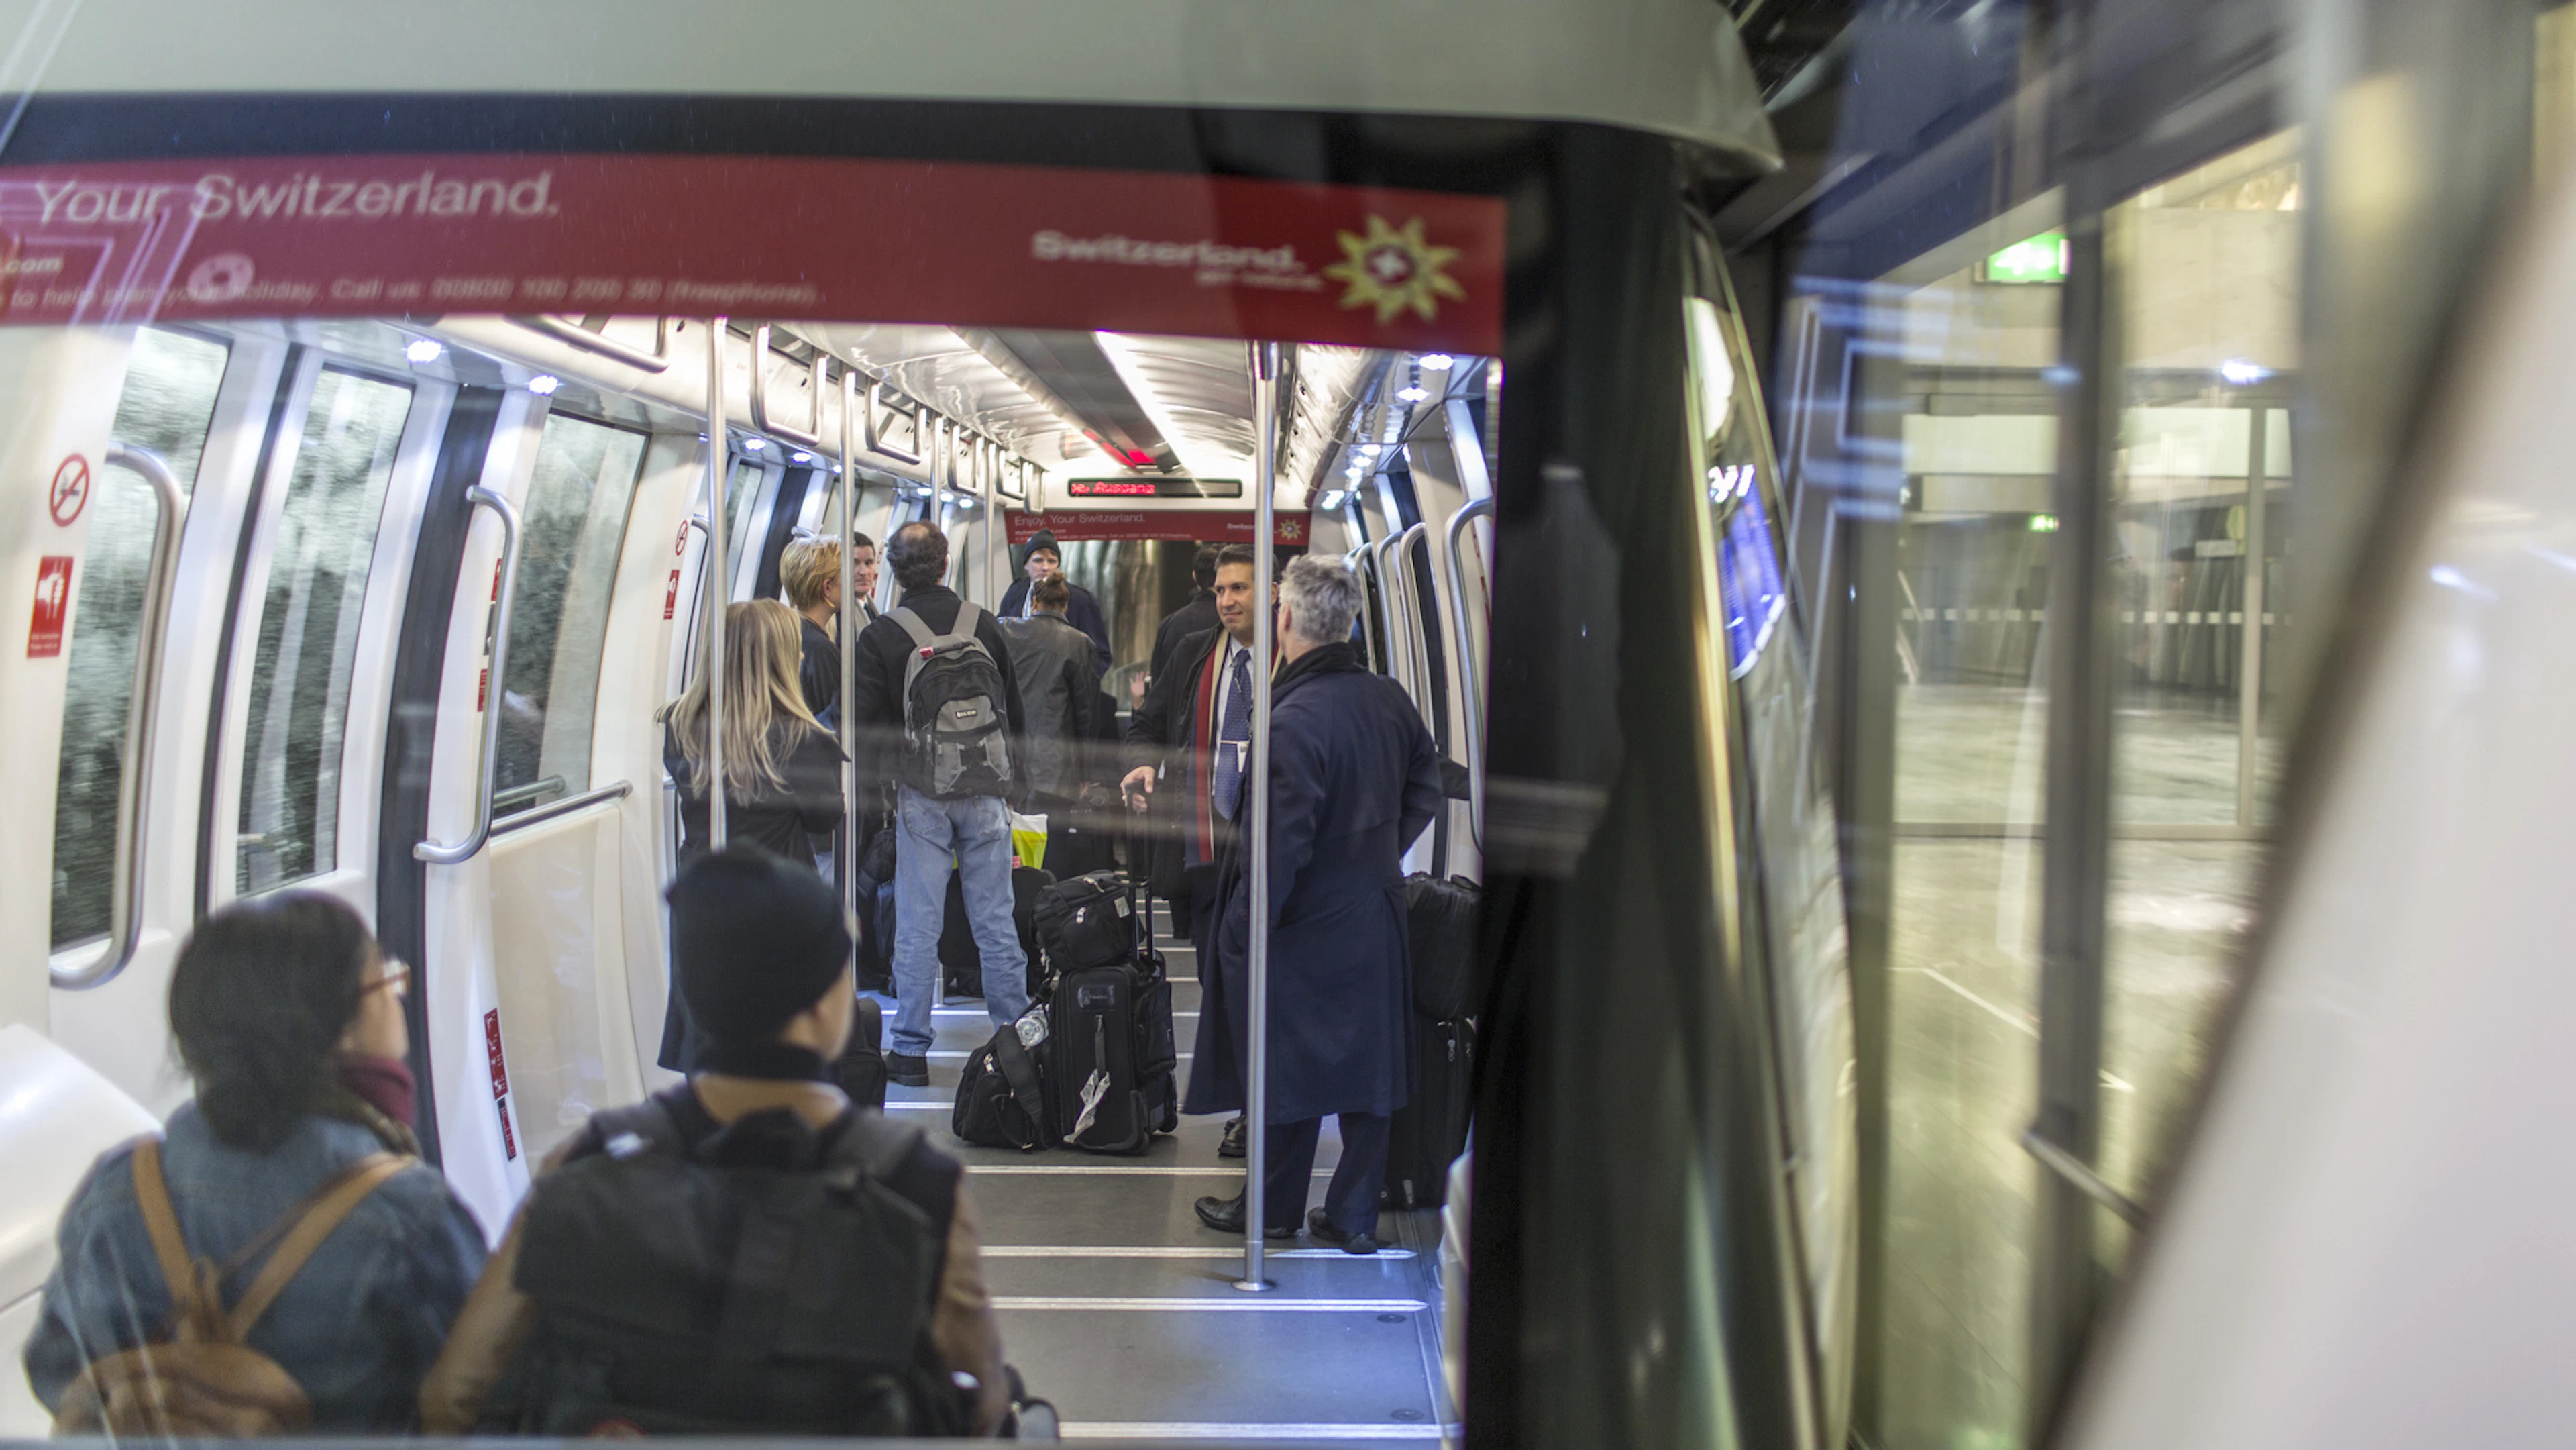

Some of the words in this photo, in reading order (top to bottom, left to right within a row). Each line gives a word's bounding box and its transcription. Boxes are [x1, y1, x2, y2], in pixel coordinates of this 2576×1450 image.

[36, 180, 169, 225] Your
[190, 171, 560, 220] Switzerland.
[1014, 515, 1046, 527] Enjoy.
[1050, 514, 1076, 524] Your
[1079, 511, 1146, 523] Switzerland.
